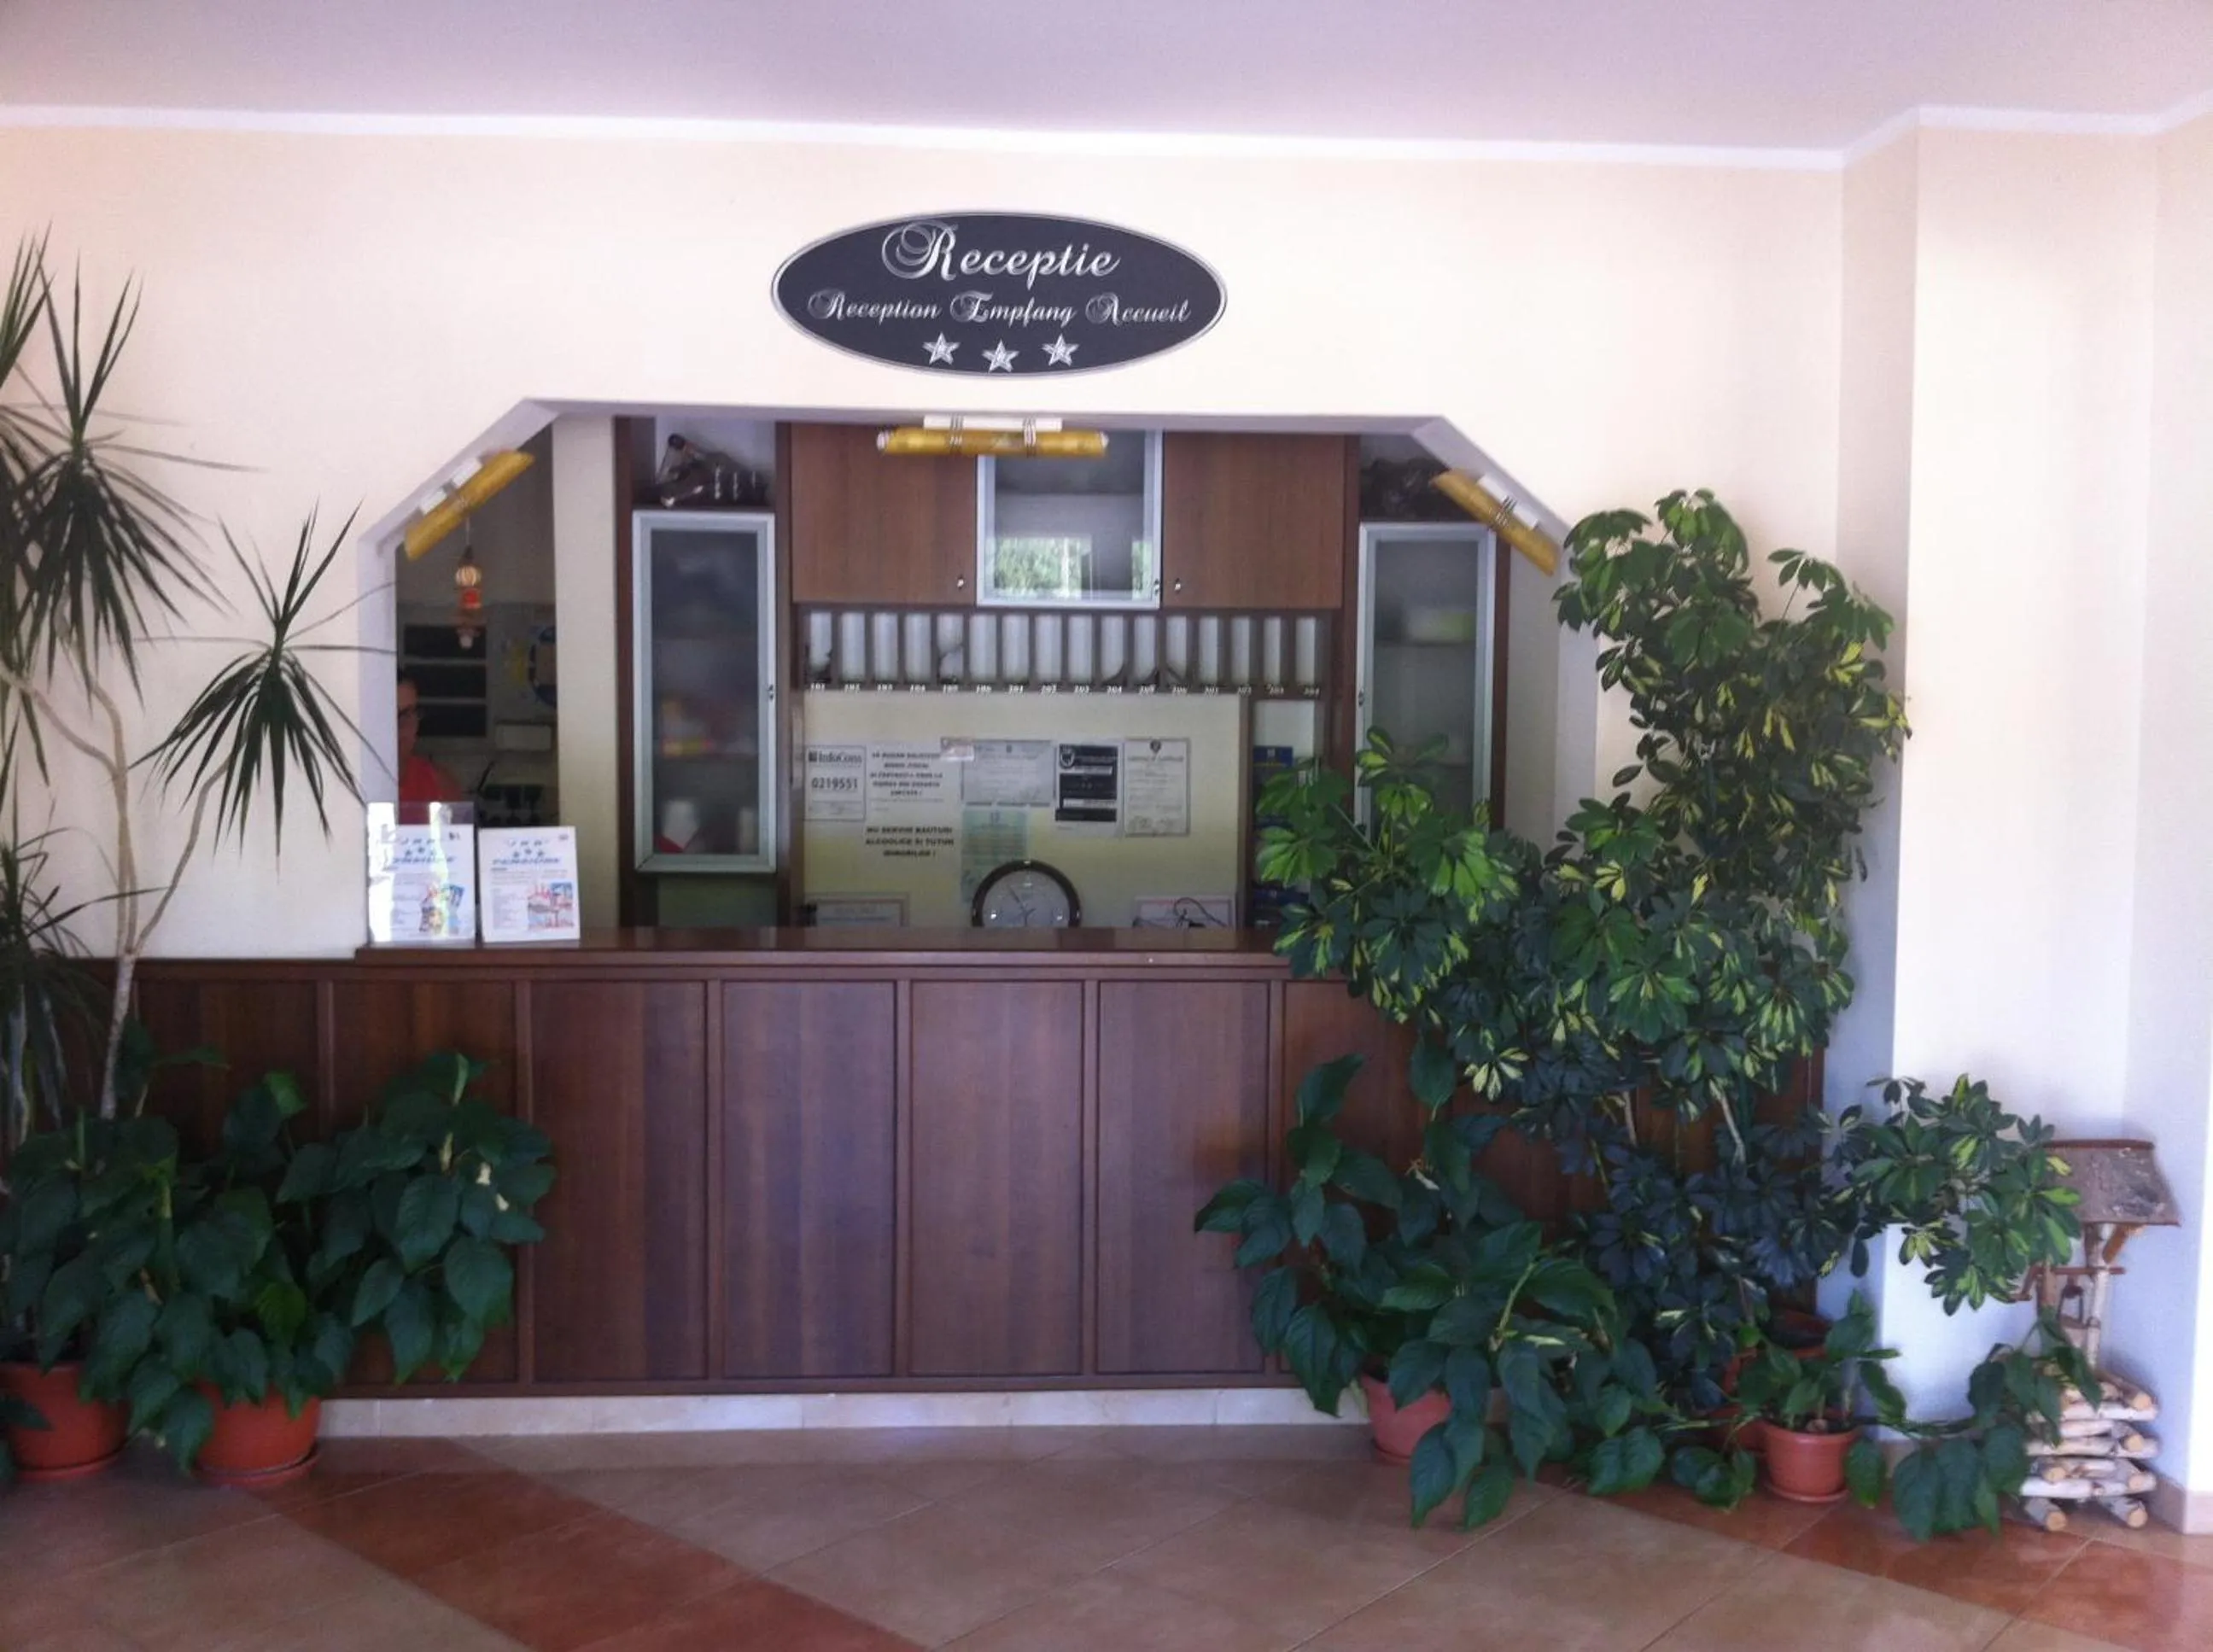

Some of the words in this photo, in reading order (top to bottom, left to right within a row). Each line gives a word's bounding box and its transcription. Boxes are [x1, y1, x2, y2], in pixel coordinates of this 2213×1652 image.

[881, 220, 1121, 290] Receptie
[807, 288, 943, 324] Reception
[949, 290, 1077, 327] Empfang
[1085, 292, 1192, 325] Accueil
[812, 777, 858, 791] 0219551
